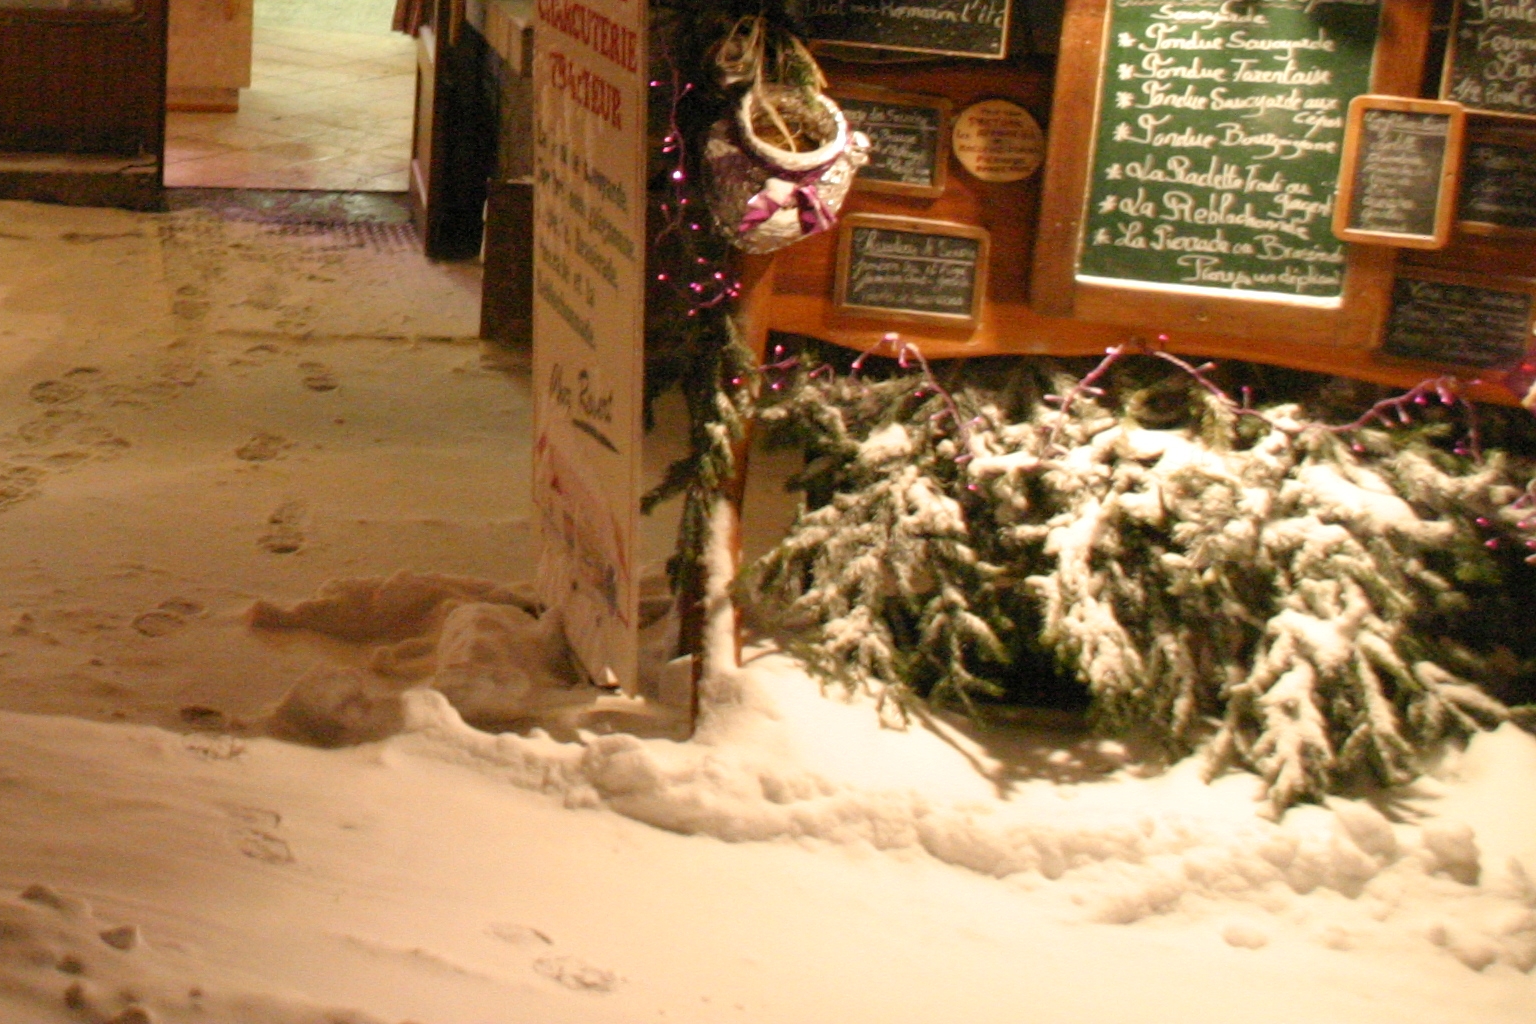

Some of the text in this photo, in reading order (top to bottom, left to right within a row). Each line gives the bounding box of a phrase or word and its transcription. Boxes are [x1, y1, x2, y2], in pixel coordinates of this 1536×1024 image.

[1139, 23, 1225, 52] Fondue
[1135, 52, 1228, 82] Fondue
[1135, 80, 1209, 110] Fondue
[1130, 114, 1218, 149] Fondue
